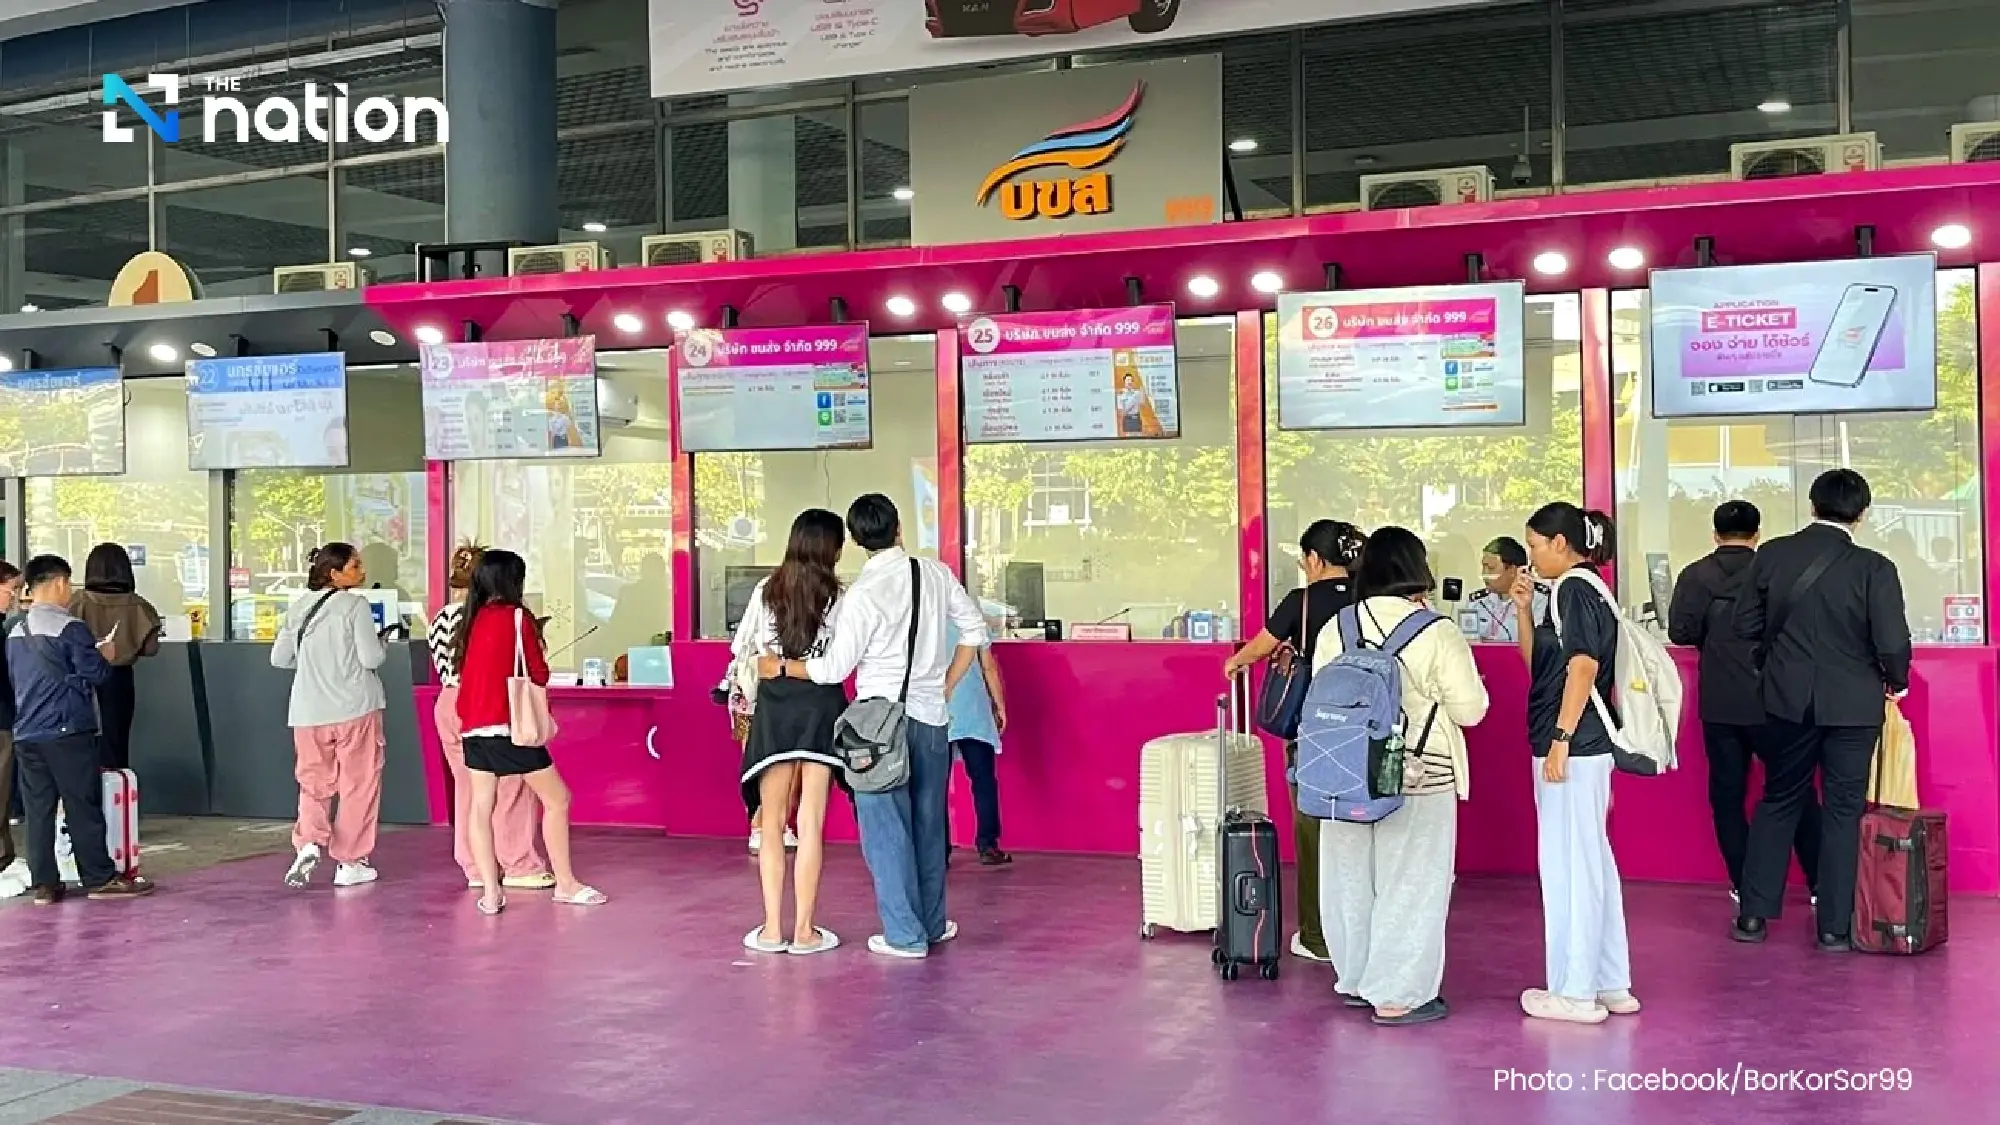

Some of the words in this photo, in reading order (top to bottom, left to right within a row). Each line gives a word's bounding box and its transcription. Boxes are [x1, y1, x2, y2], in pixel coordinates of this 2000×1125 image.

[1000, 172, 1111, 219] บขส
[1313, 316, 1333, 331] 26
[1442, 311, 1467, 324] 999
[1706, 312, 1792, 329] E-TICKET
[973, 327, 994, 344] 25
[1114, 321, 1140, 336] 999
[689, 343, 707, 358] 24
[814, 338, 838, 351] 999
